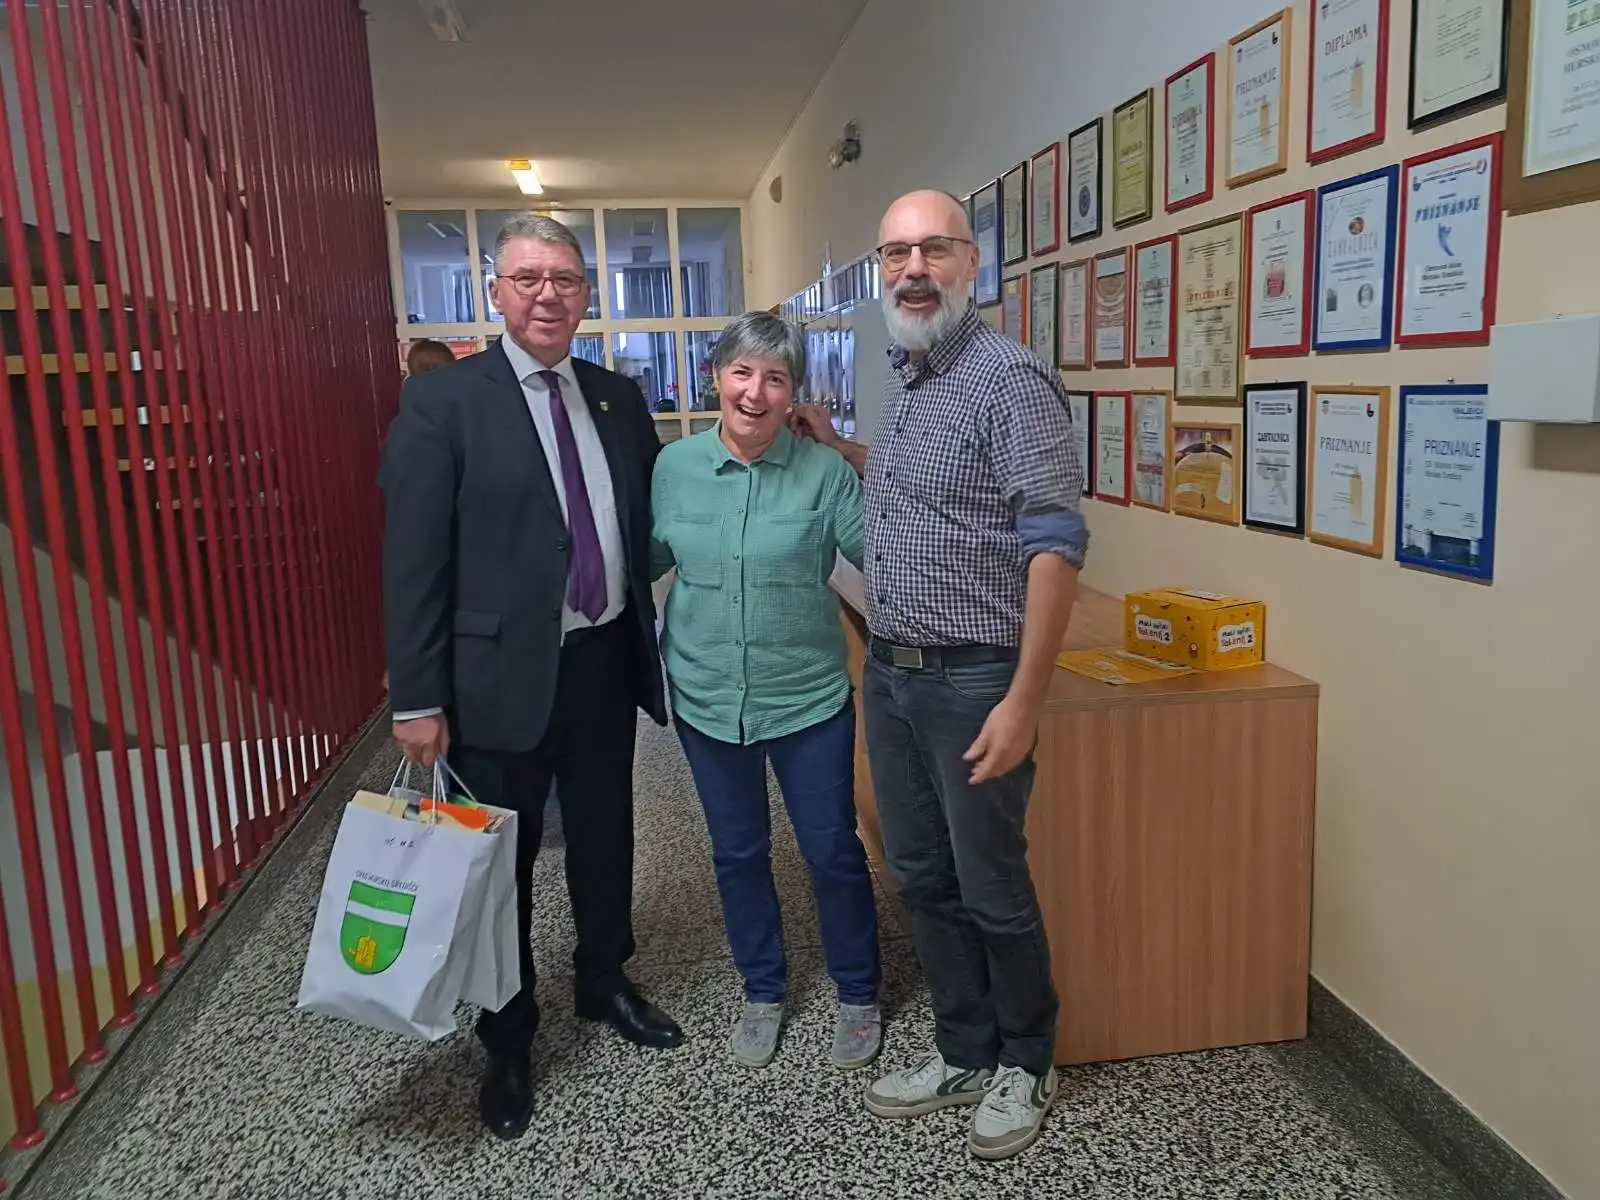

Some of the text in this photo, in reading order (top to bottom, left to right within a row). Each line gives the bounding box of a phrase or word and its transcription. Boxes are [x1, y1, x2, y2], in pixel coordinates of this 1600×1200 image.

[1325, 22, 1368, 56] DIPLOMA
[1236, 66, 1277, 98] PRIZNANJE
[1414, 195, 1480, 223] PRIZNANJE
[1320, 436, 1373, 455] PRIZNANJE
[1424, 439, 1481, 458] PRIZNANJE
[1164, 632, 1171, 641] 2
[1247, 634, 1253, 643] 2
